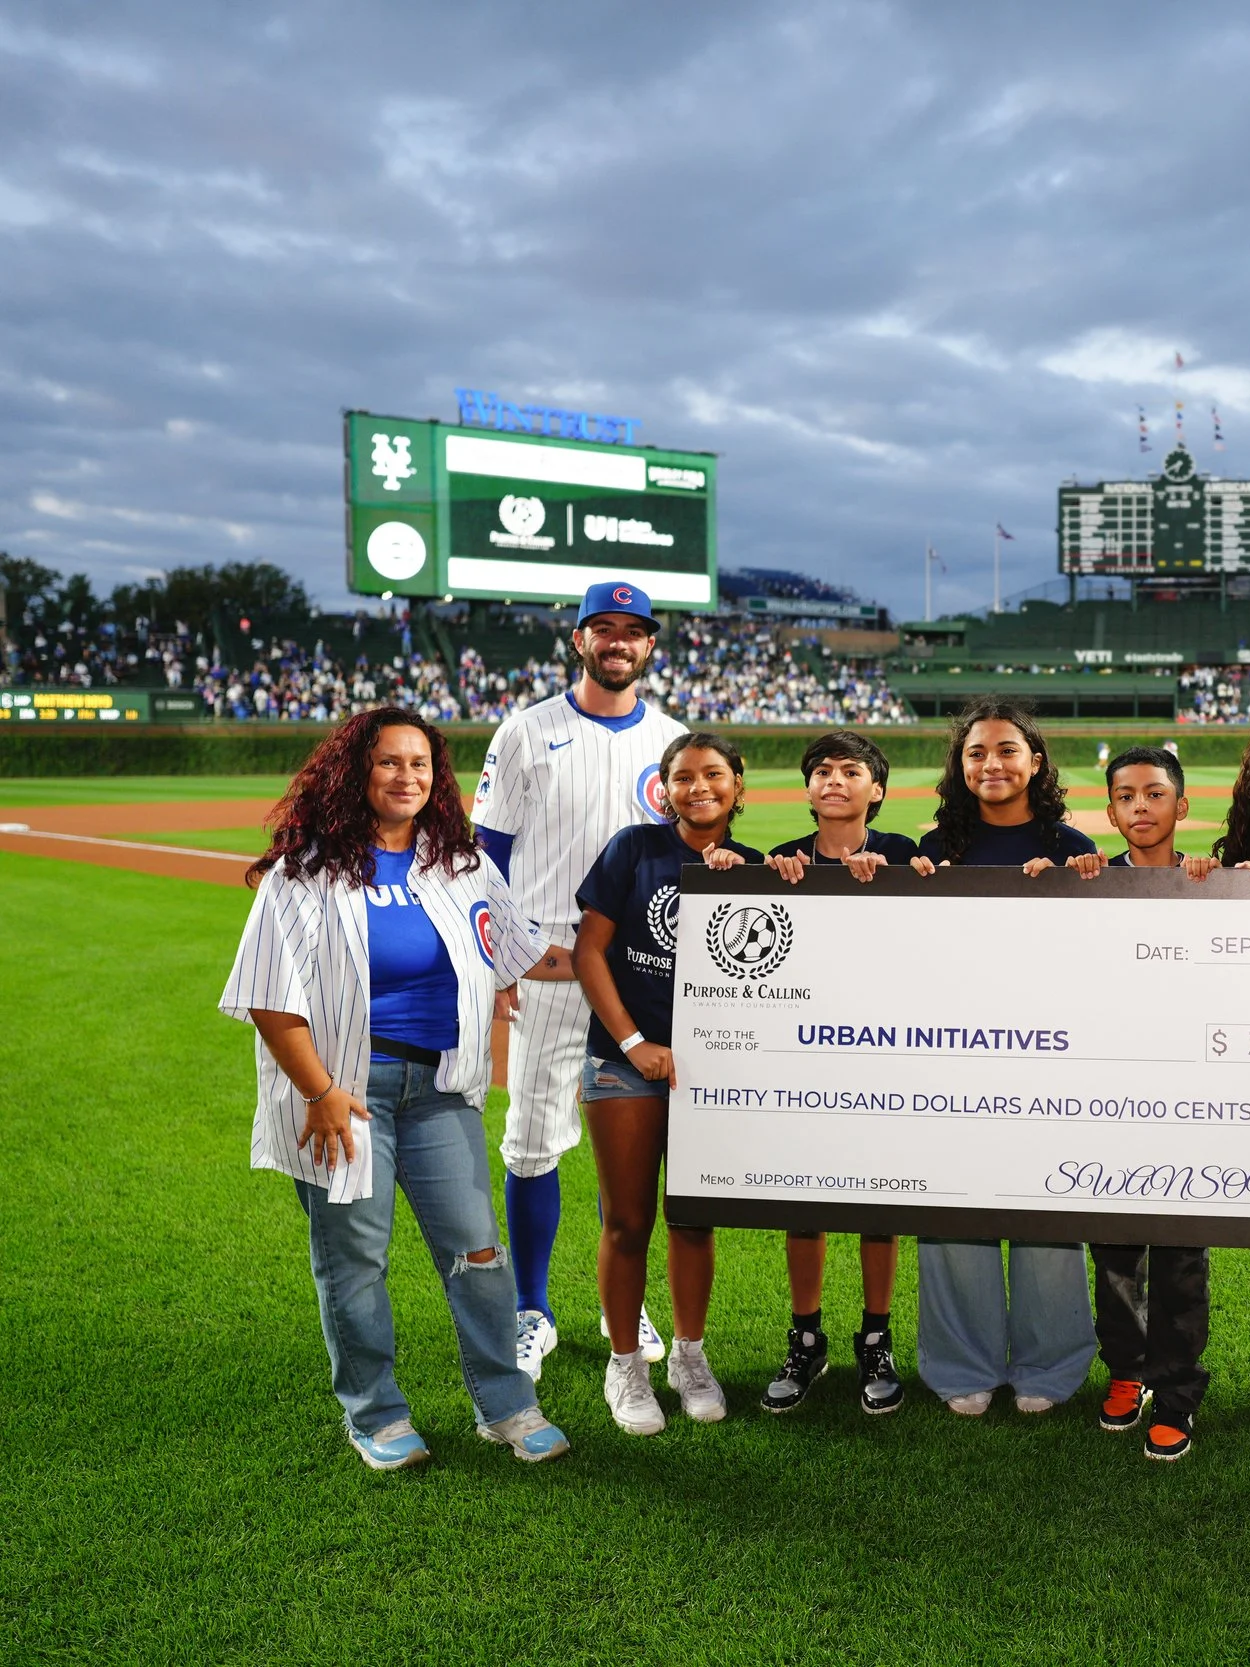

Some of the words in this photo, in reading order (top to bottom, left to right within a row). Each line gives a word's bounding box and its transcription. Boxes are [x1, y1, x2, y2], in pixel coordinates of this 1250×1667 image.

[455, 387, 642, 445] WINTRUST
[612, 587, 632, 604] C
[1075, 650, 1112, 663] YETI
[627, 946, 673, 970] PURPOSE
[1136, 943, 1189, 961] DATE:
[633, 965, 670, 978] SWANSON
[683, 982, 738, 999] PURPOSE
[742, 984, 753, 999] &
[758, 984, 811, 1001] CALLING
[693, 1027, 713, 1040] PAY
[717, 1030, 731, 1040] TO
[734, 1030, 755, 1041] THE
[797, 1024, 896, 1048] URBAN
[906, 1026, 1069, 1052] INITIATIVES
[1211, 1028, 1228, 1057] $
[705, 1041, 742, 1051] ORDER
[744, 1041, 760, 1051] OF
[690, 1087, 768, 1107] THIRTY
[774, 1089, 905, 1111] THOUSAND
[913, 1093, 1022, 1116] DOLLARS
[1028, 1097, 1082, 1116] AND
[1088, 1097, 1167, 1119] 00/100
[700, 1174, 735, 1186] MEMO
[744, 1173, 813, 1188] SUPPORT
[816, 1176, 867, 1189] YOUTH
[869, 1178, 928, 1192] SPORTS
